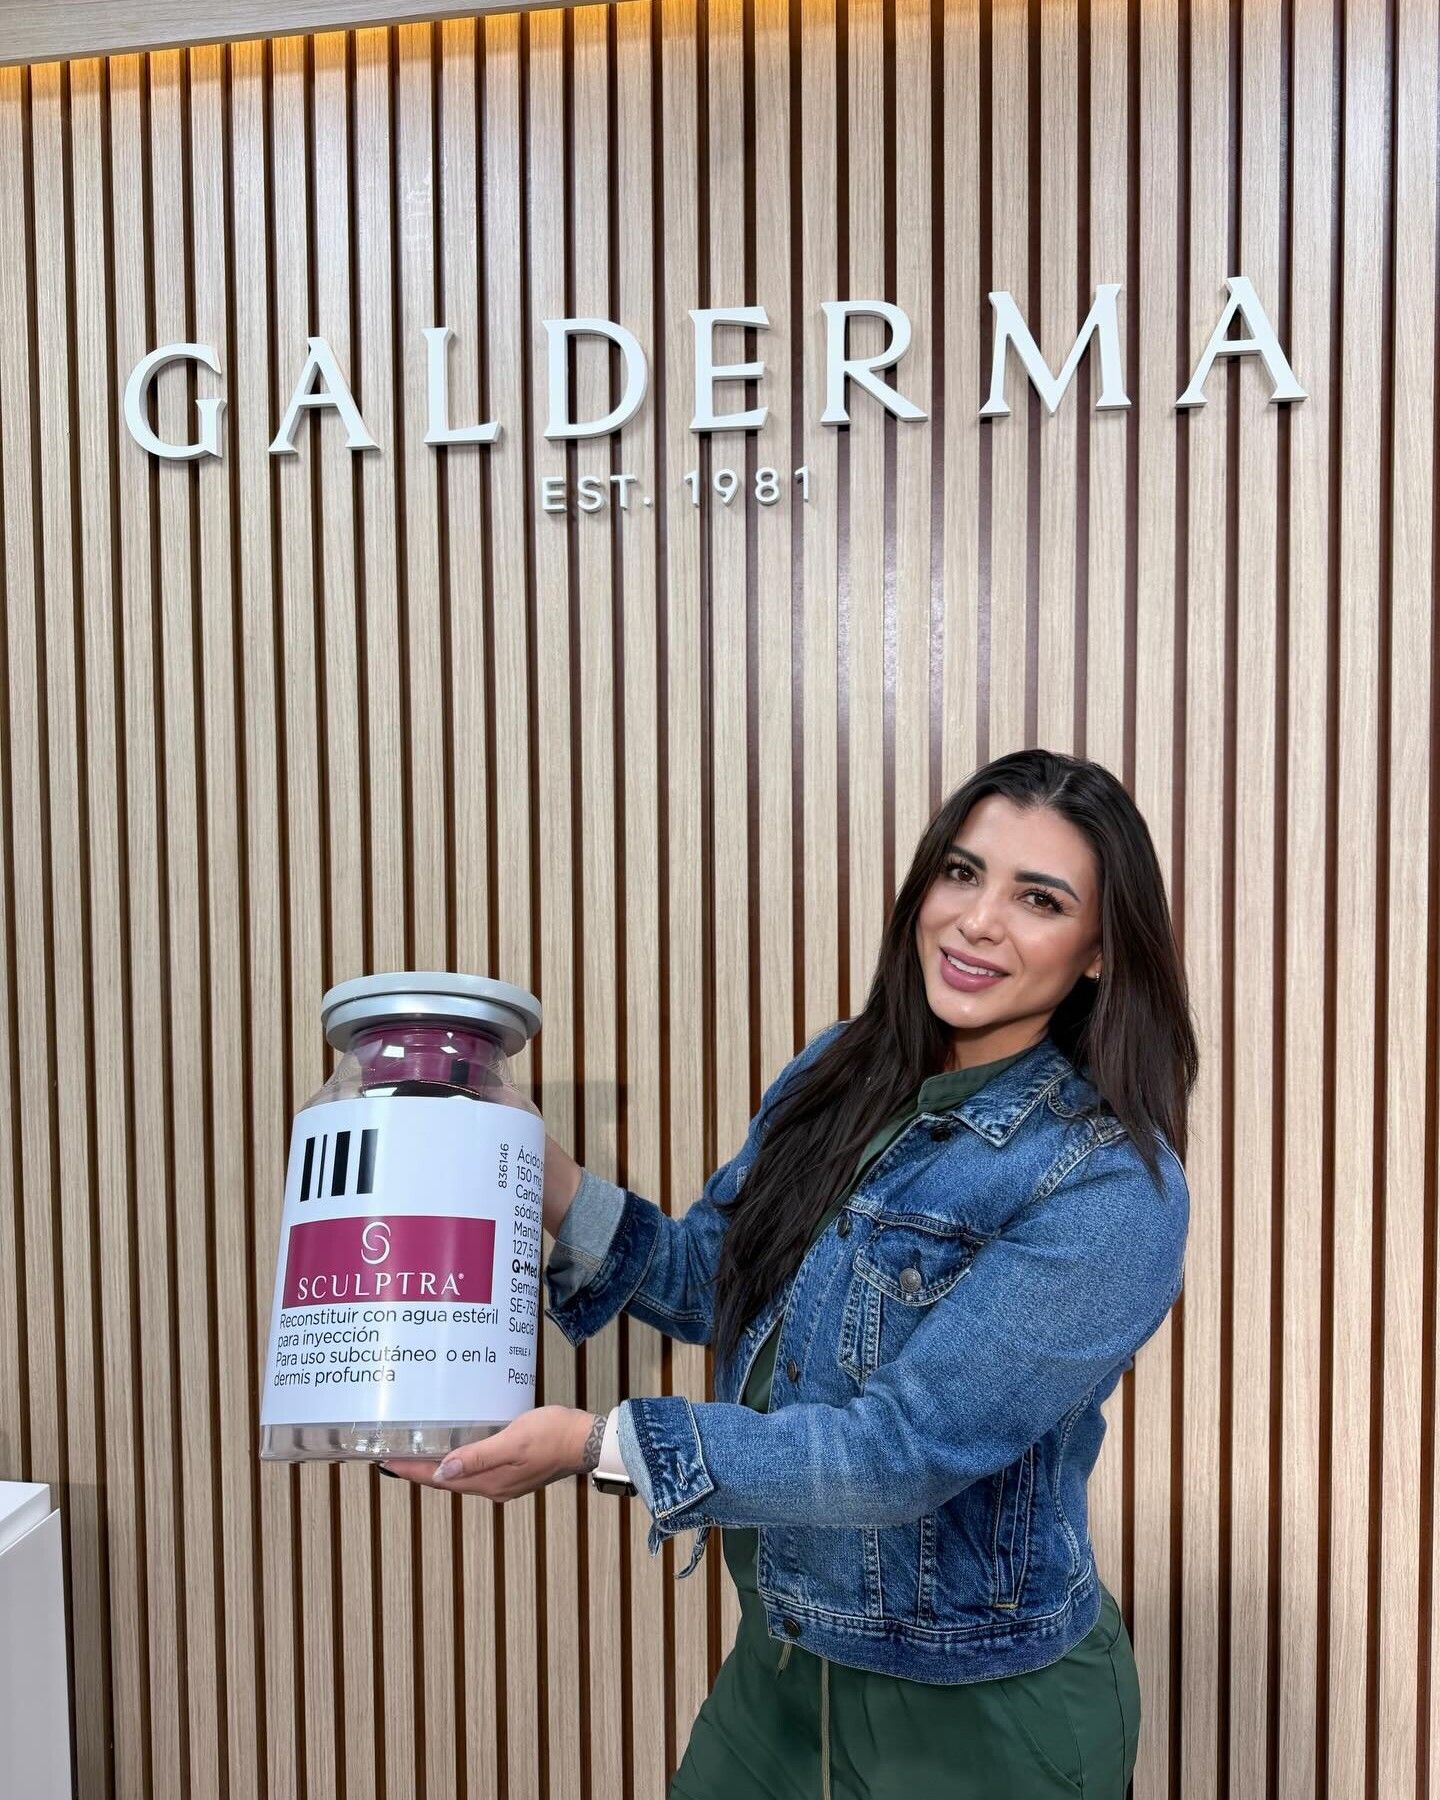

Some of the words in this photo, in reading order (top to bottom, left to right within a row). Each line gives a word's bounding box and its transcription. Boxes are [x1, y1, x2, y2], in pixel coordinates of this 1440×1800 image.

[124, 276, 1308, 461] GALDERMA
[542, 473, 653, 513] EST.
[683, 466, 812, 507] 1981
[498, 1143, 509, 1188] 836146
[516, 1165, 532, 1183] 150
[512, 1239, 534, 1259] 127,5
[512, 1259, 538, 1279] Q-Med
[280, 1310, 359, 1329] Reconstituir
[363, 1309, 396, 1323] con
[402, 1309, 447, 1325] agua
[452, 1308, 498, 1325] estéril
[509, 1316, 534, 1336] Suecia
[278, 1332, 299, 1350] para
[302, 1327, 379, 1348] inyección
[276, 1351, 298, 1368] Para
[301, 1351, 325, 1365] uso
[330, 1346, 436, 1364] subcutáneo
[446, 1351, 457, 1362] o
[462, 1351, 481, 1362] en
[486, 1347, 496, 1363] la
[274, 1370, 310, 1387] dermis
[315, 1366, 395, 1387] profunda
[508, 1368, 529, 1385] Peso
